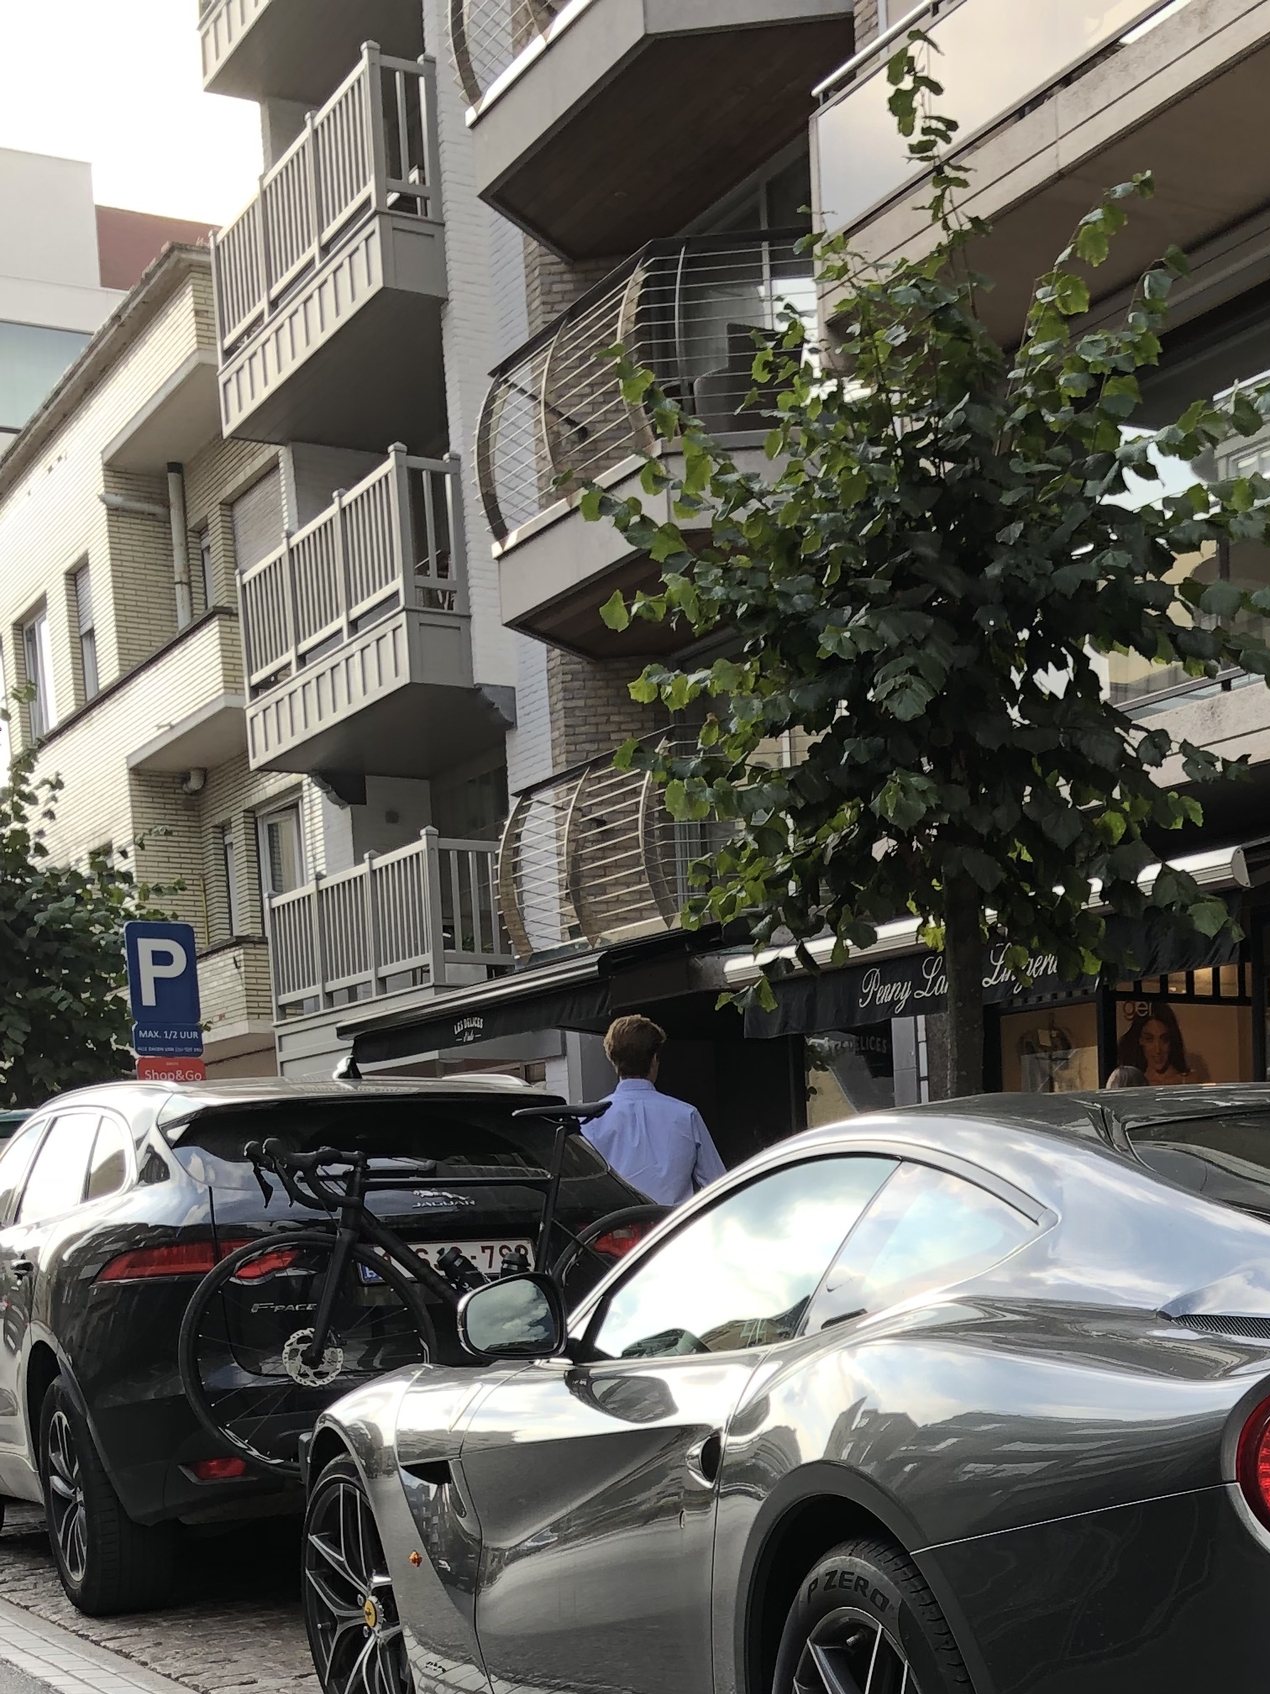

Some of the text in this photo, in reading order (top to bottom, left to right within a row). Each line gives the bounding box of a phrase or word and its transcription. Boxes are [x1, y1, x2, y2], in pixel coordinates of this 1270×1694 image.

[136, 937, 187, 1007] P
[859, 968, 912, 1014] Penny
[138, 1030, 199, 1040] MAX. 1/2 UUR
[144, 1069, 202, 1082] Shop&Go
[806, 1570, 891, 1613] P ZERO
